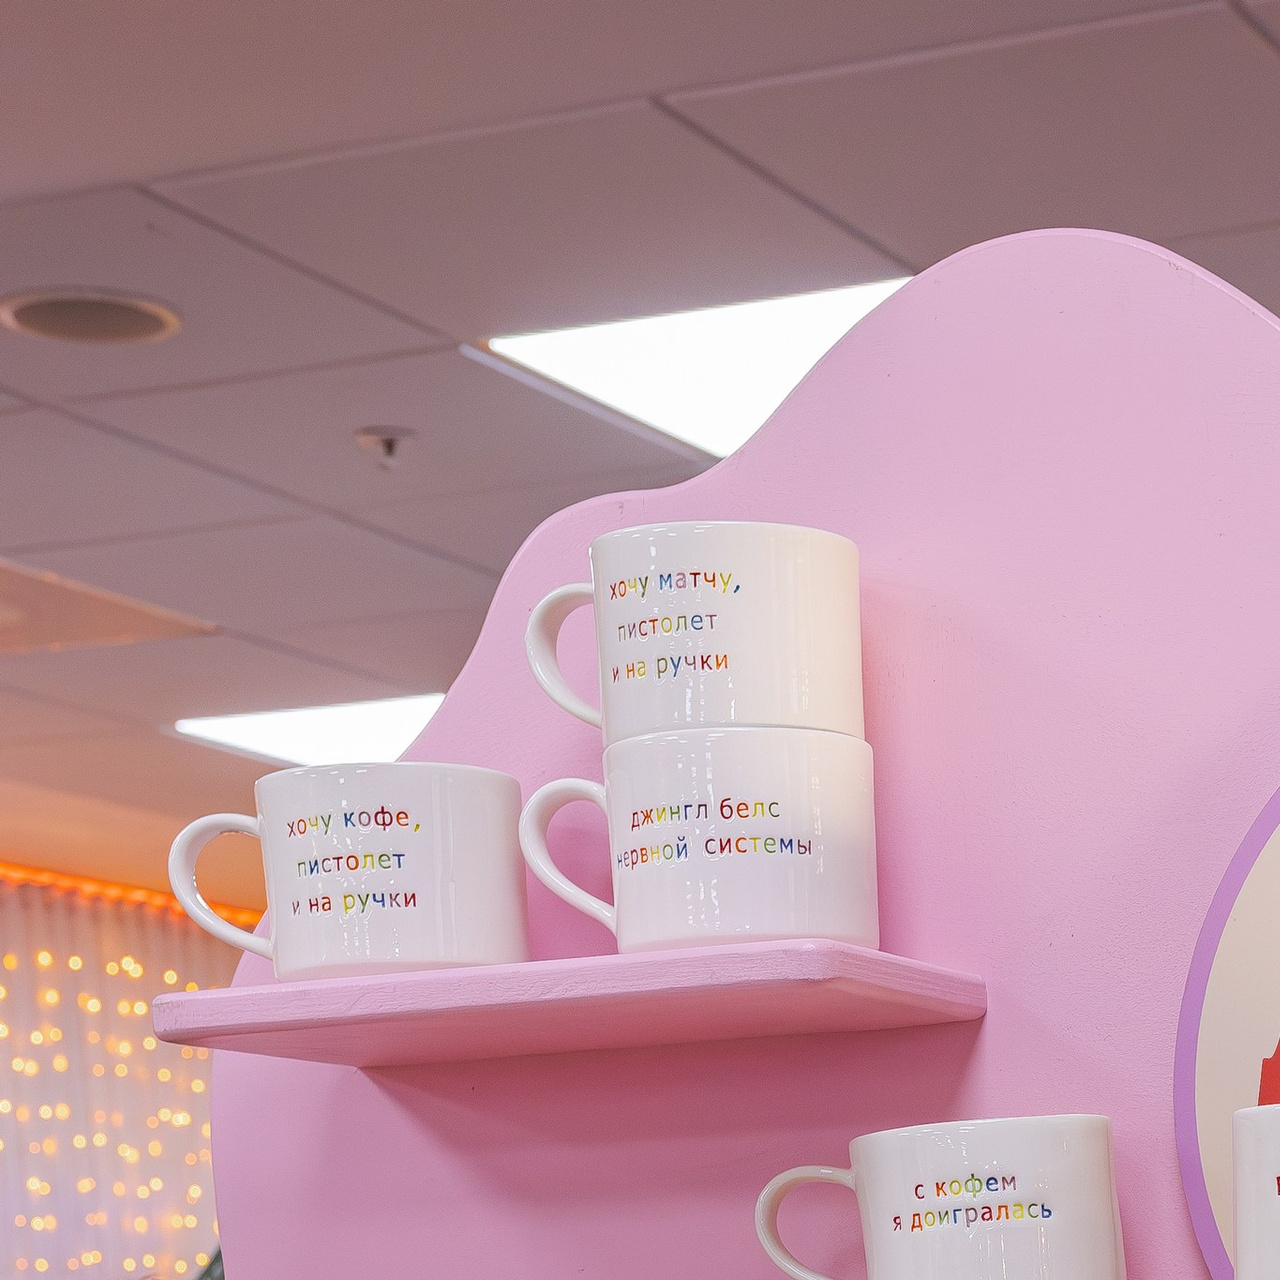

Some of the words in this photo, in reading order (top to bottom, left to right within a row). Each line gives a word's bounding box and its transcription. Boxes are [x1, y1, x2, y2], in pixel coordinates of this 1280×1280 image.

[609, 576, 649, 600] хочу
[659, 571, 741, 594] матчу,
[617, 613, 717, 642] пистолет
[612, 665, 619, 683] и
[626, 660, 646, 679] на
[657, 654, 729, 679] ручки
[287, 814, 331, 837] хочу
[344, 806, 420, 832] кофе,
[631, 803, 708, 831] джингл
[720, 798, 780, 820] белс
[297, 854, 405, 877] пистолет
[617, 836, 688, 870] нервной
[704, 836, 812, 855] системы
[292, 900, 300, 915] и
[309, 896, 331, 912] на
[343, 893, 416, 914] ручки
[914, 1183, 924, 1199] с
[935, 1174, 1017, 1198] кофем
[893, 1216, 902, 1231] я
[911, 1202, 1052, 1232] доигралась
